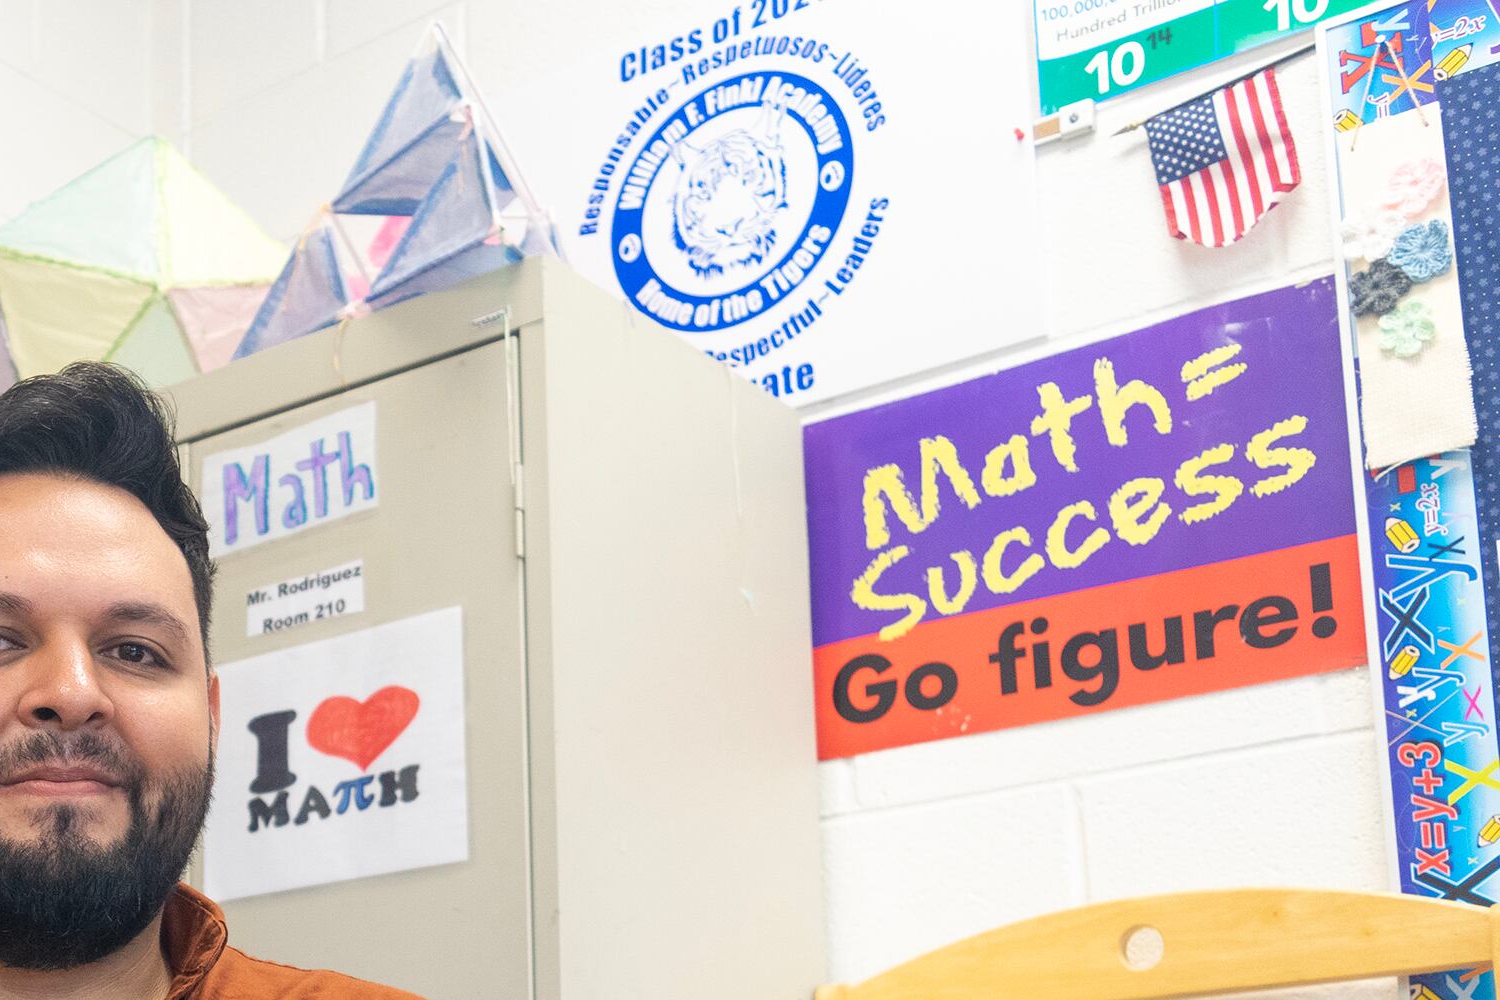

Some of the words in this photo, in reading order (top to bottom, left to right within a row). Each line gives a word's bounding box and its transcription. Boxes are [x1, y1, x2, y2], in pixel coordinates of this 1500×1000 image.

[620, 29, 702, 82] Class
[713, 6, 742, 43] of
[1056, 9, 1128, 41] Hundred
[1084, 41, 1145, 94] 10
[760, 75, 843, 155] Academy
[635, 278, 695, 327] Home
[720, 289, 764, 323] the
[760, 223, 832, 300] Tigers
[704, 298, 823, 368] espectful
[751, 362, 815, 398] ate
[222, 430, 376, 545] Math
[850, 414, 1317, 642] Success
[246, 590, 272, 606] Mr.
[277, 566, 362, 598] Rodriguez
[262, 611, 309, 634] Room
[315, 598, 346, 620] 210
[831, 652, 959, 725] Go
[988, 562, 1338, 707] figure!
[247, 709, 297, 794] I
